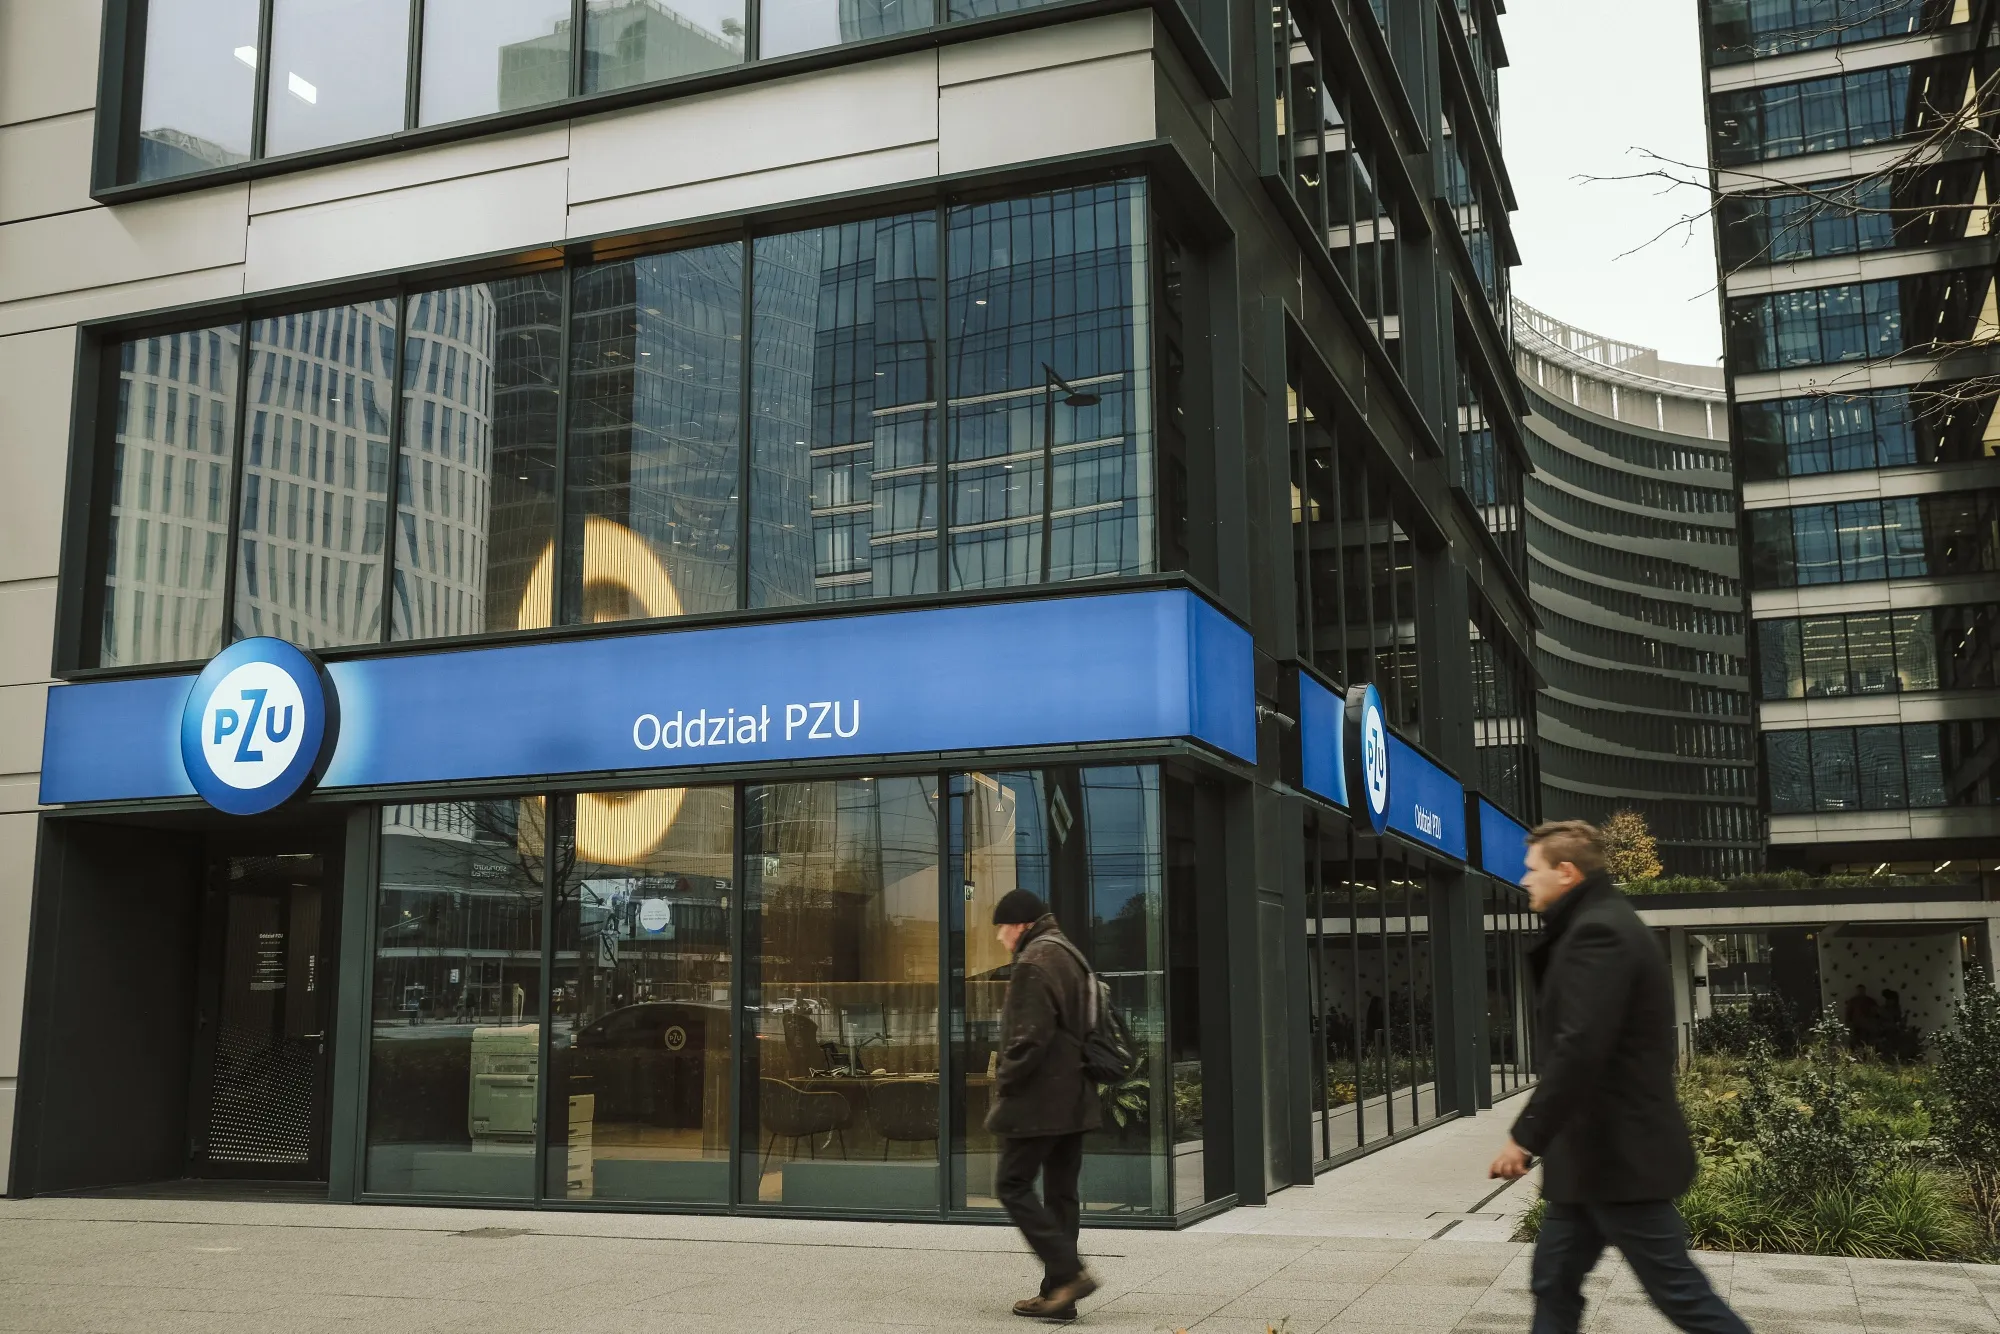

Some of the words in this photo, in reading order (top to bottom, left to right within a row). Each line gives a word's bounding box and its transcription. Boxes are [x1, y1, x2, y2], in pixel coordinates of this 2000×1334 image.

[213, 688, 293, 762] PZU
[633, 704, 770, 751] Oddział
[786, 700, 859, 741] PZU
[1368, 727, 1384, 792] PZU
[669, 1032, 682, 1044] PZU
